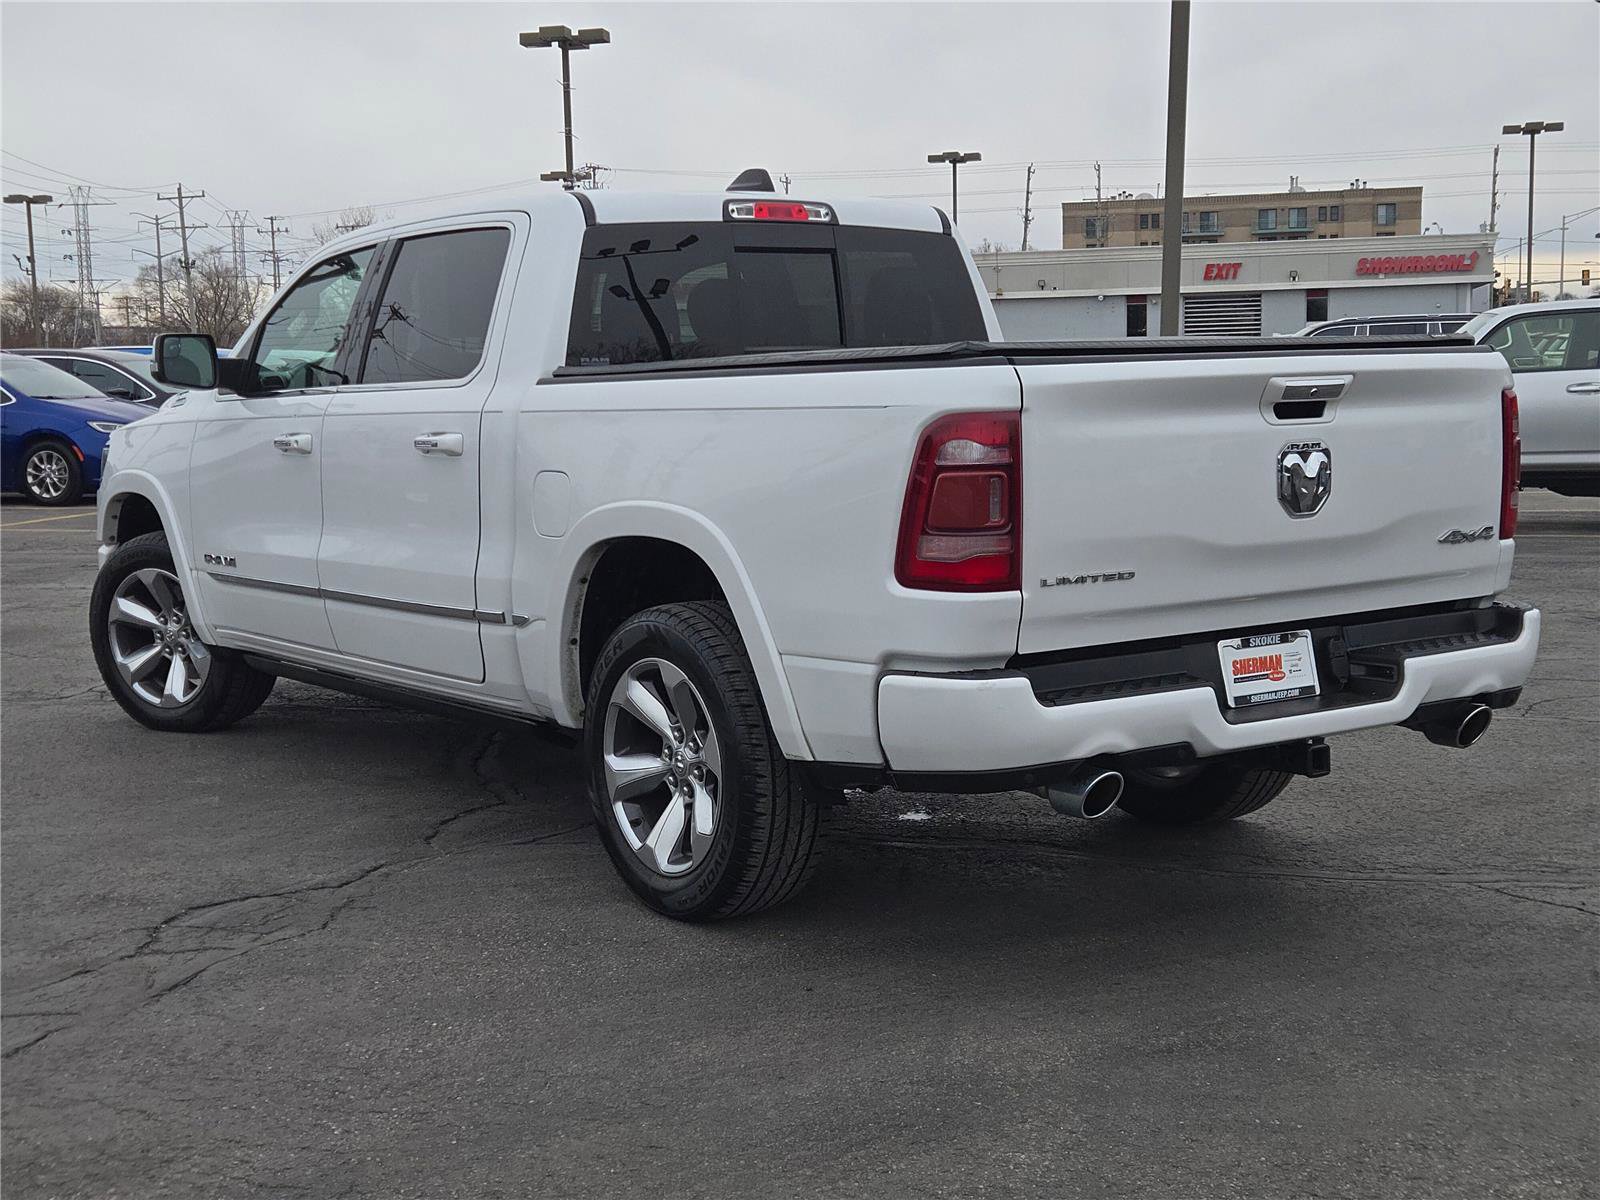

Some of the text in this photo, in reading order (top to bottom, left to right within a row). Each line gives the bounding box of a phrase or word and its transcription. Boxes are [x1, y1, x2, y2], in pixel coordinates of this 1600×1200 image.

[1203, 262, 1242, 281] EXIT
[1356, 254, 1468, 276] SHOWROOM
[1290, 442, 1322, 450] RAM
[203, 553, 237, 568] RAM
[1040, 571, 1135, 588] LIMITED
[1249, 635, 1281, 647] SKOKIE
[1232, 653, 1283, 676] SHERMAN
[1250, 689, 1300, 703] SHERMANJEEP.COM
